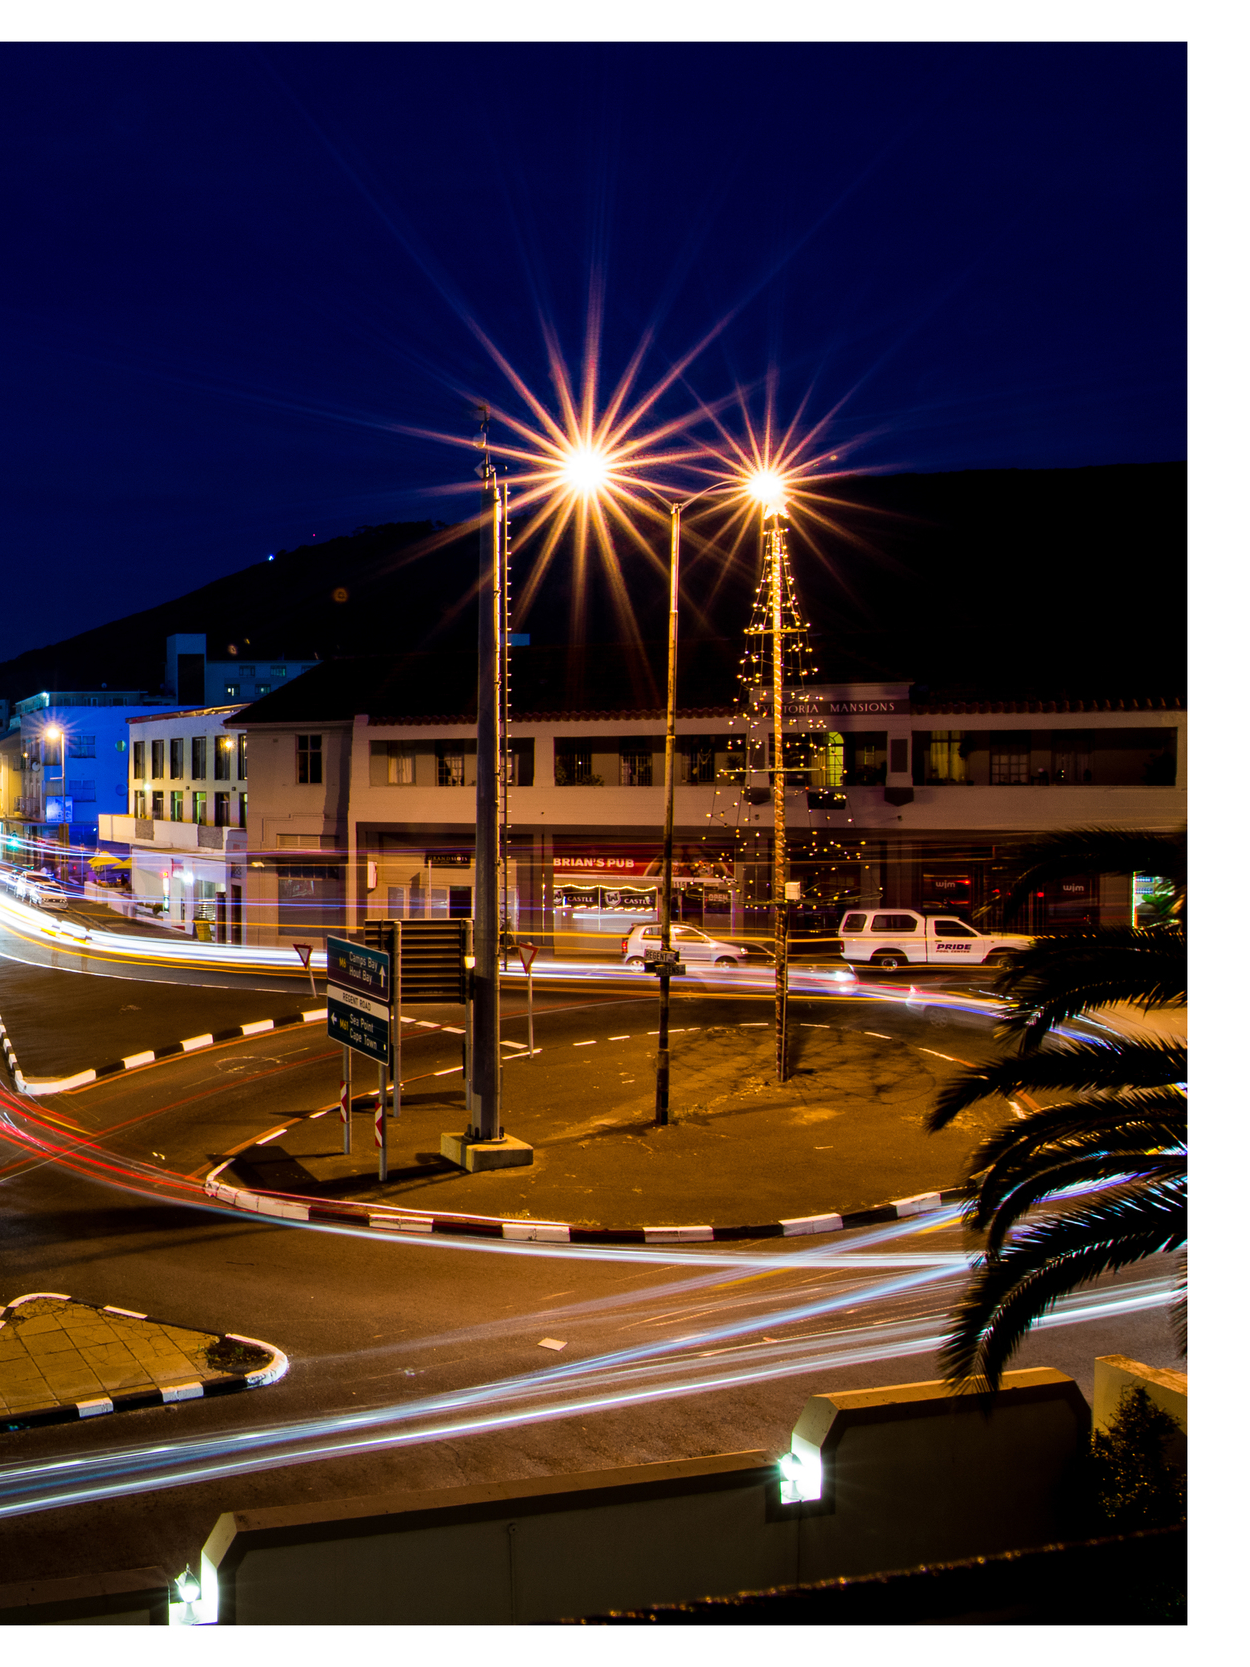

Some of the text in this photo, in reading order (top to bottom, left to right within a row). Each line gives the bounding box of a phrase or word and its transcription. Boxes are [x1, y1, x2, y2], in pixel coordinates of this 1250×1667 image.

[763, 702, 895, 714] VITORIA MANSIONS
[553, 857, 635, 868] BRIAN'S PUB
[339, 957, 347, 968] M6
[349, 951, 378, 973] Camps Bay
[646, 950, 668, 962] REGENT
[349, 965, 373, 985] Hout Bay
[342, 992, 372, 1012] REGENT ROAD
[350, 1013, 374, 1033] Sea Point
[350, 1027, 377, 1050] Cape Town
